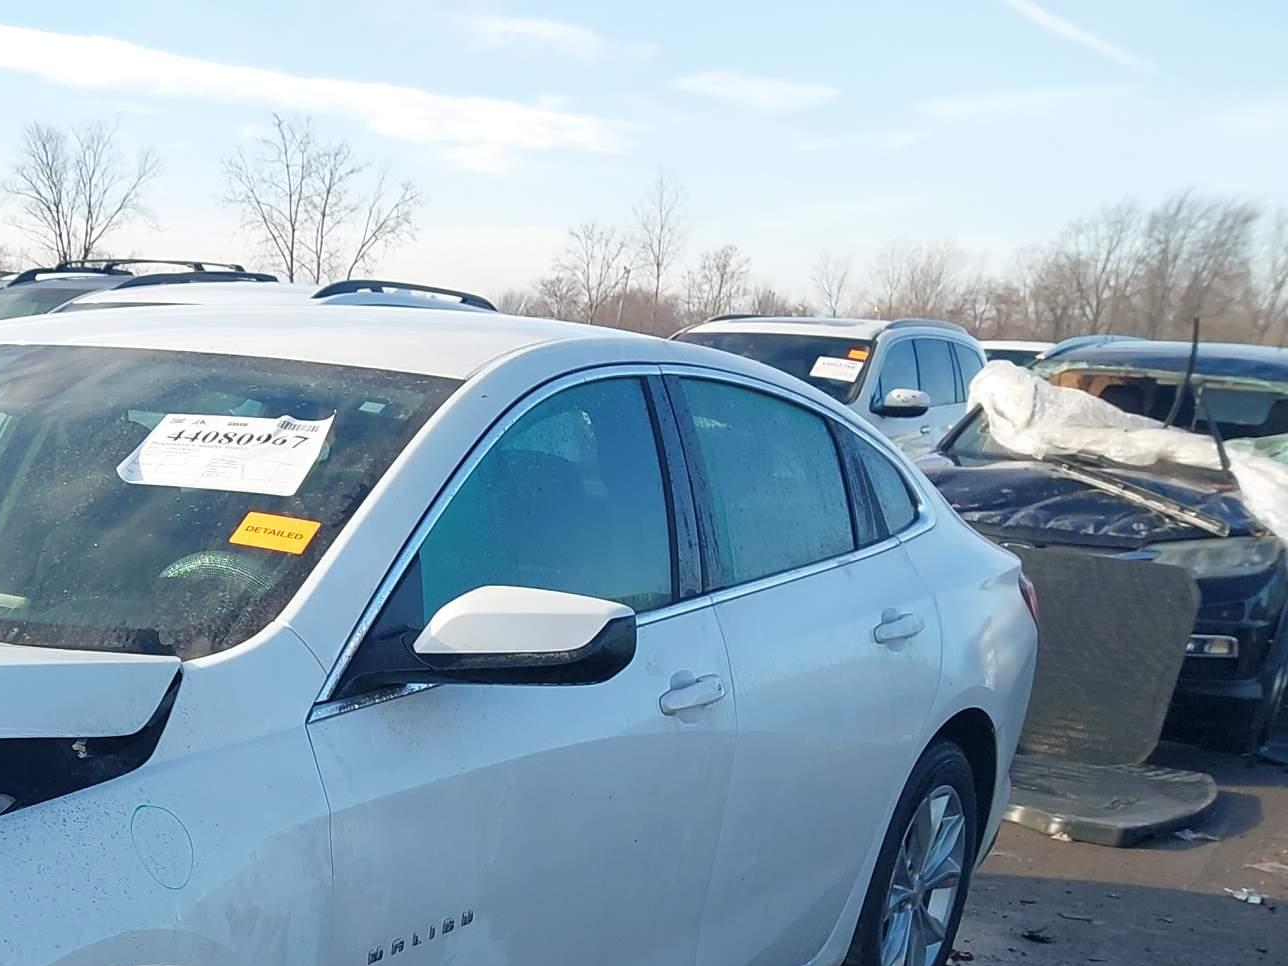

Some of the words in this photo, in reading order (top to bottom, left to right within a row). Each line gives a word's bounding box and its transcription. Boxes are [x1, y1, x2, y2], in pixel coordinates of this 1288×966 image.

[166, 429, 310, 449] 44080967
[244, 525, 304, 540] DETAILED
[367, 909, 474, 965] MALIBU
